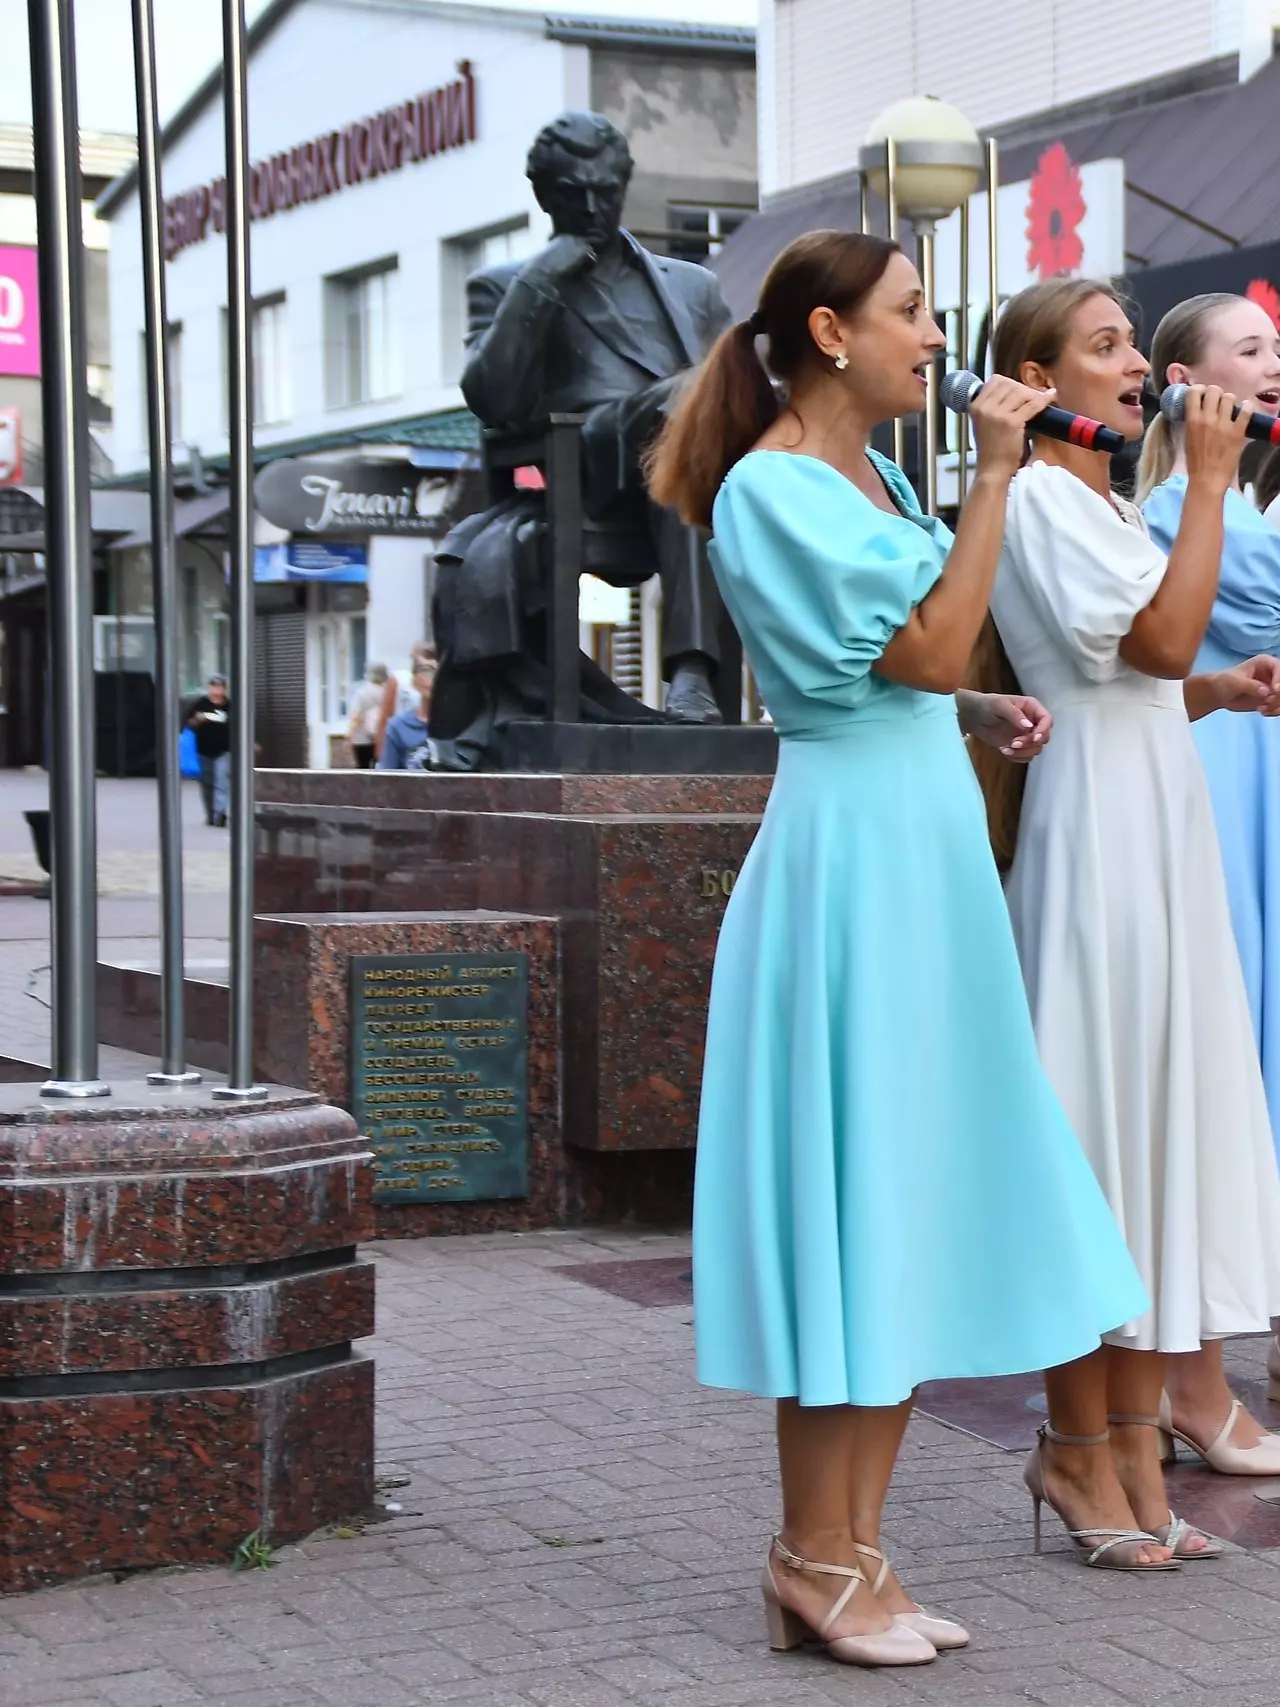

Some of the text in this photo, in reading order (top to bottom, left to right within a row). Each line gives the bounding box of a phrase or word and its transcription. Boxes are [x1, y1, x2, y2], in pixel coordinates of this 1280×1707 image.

[162, 58, 476, 262] ЕНТР НОЛЬНЫХ ПОКРЫТИЙ
[300, 475, 411, 532] Jenavi
[364, 966, 518, 981] НАРОДНЫЙ АРТИСТ
[364, 985, 490, 998] КИНОРЕЖИССЕР
[365, 1004, 434, 1016] ЛАУРЕАТ
[364, 1056, 457, 1068] СОЗДАТЕЛЬ
[365, 1073, 480, 1086] БЕССМЕРТНЫХ
